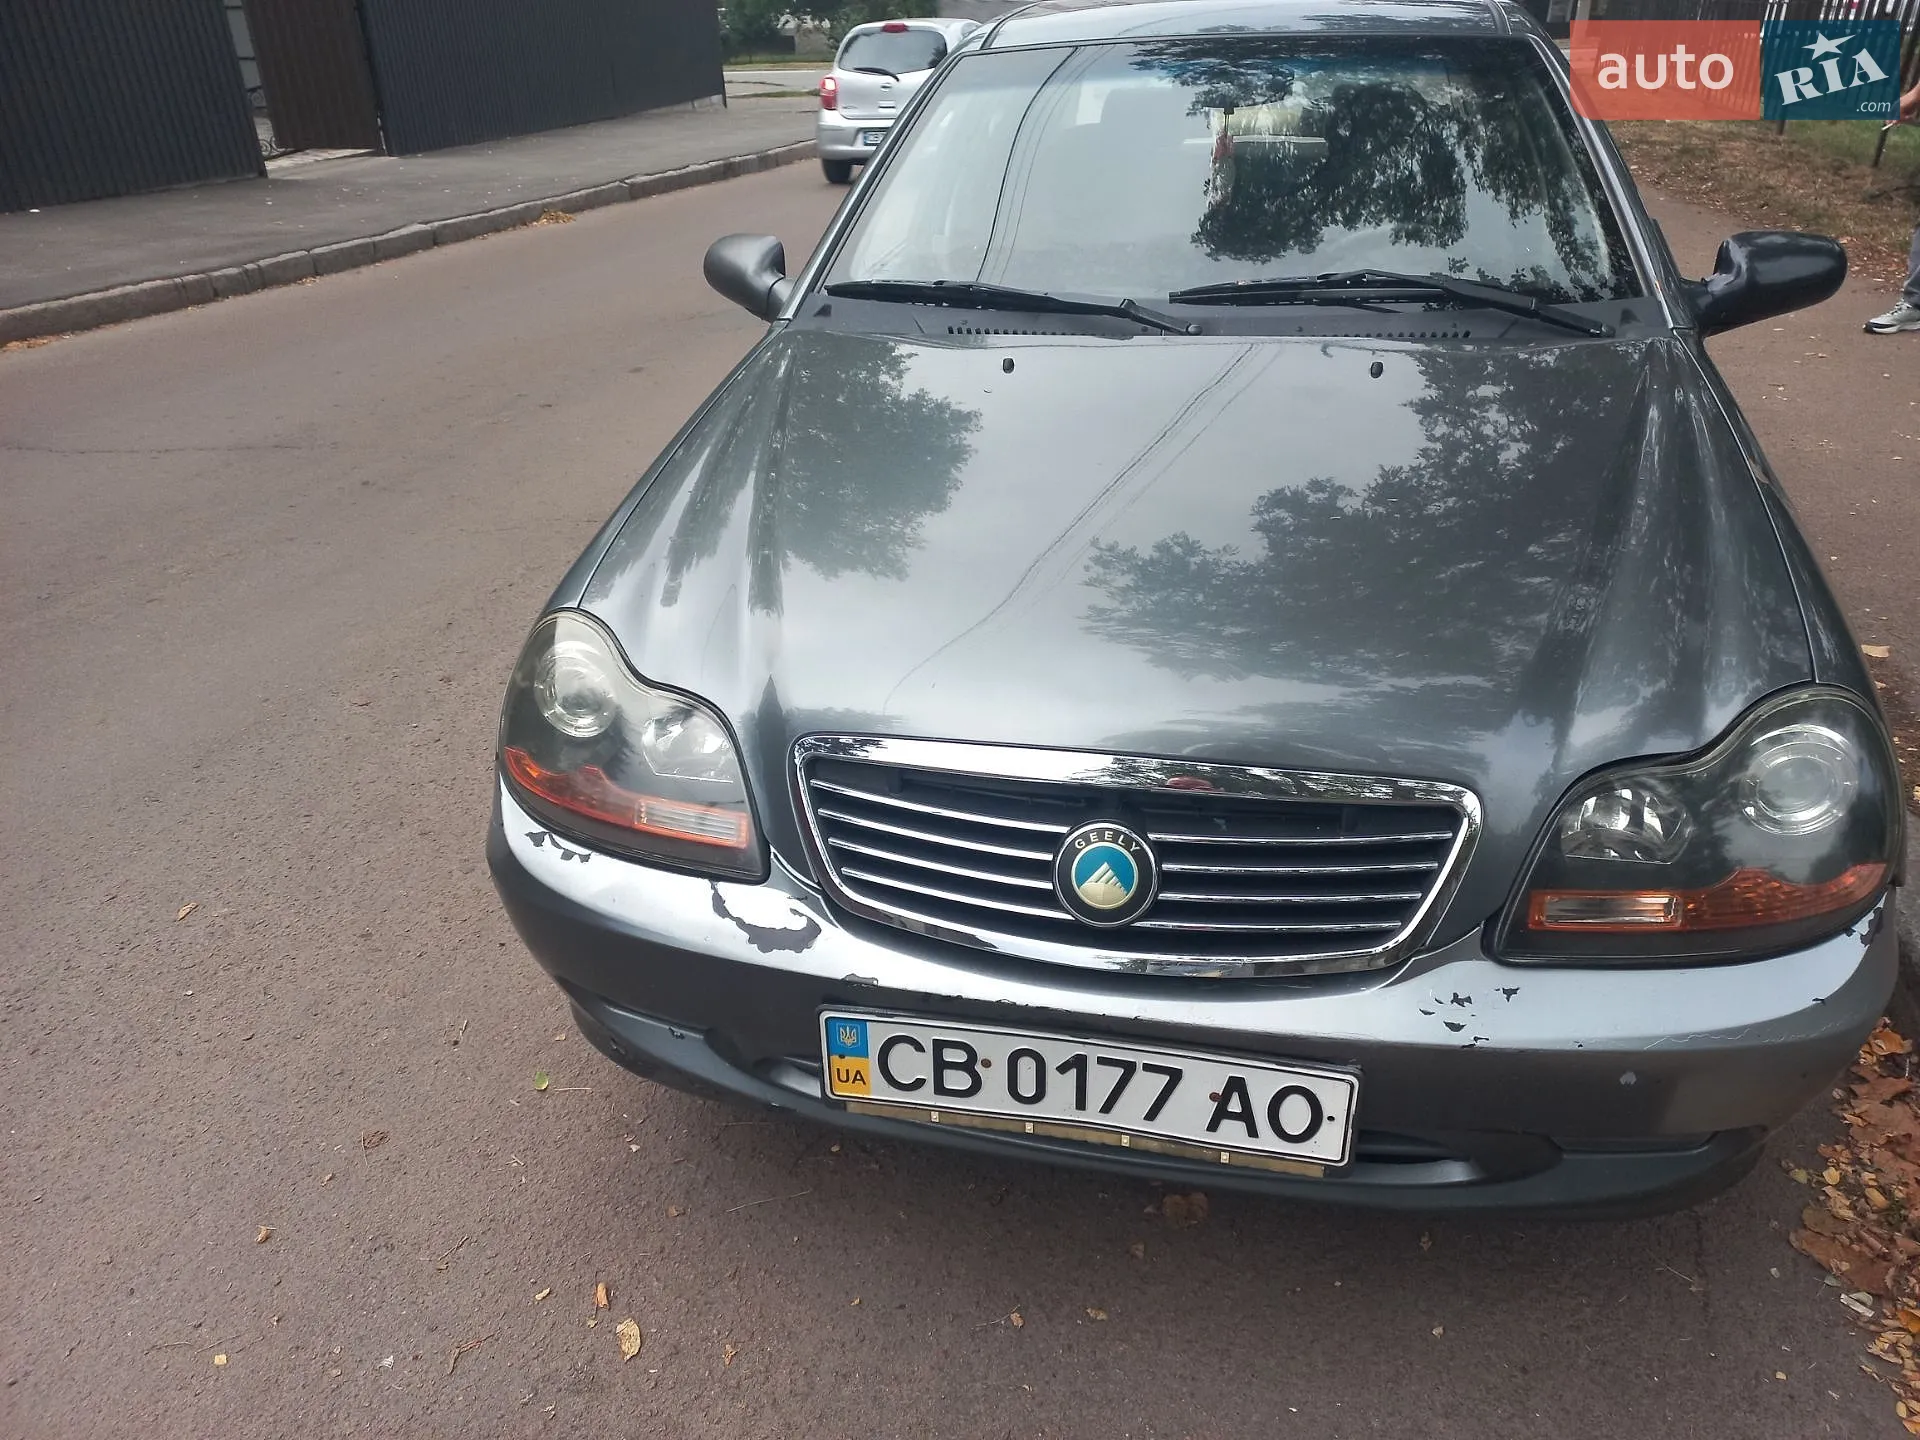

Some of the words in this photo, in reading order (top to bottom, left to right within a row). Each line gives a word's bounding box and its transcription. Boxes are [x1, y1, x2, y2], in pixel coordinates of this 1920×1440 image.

[1074, 830, 1141, 852] GEELY
[836, 1066, 867, 1086] UA
[1006, 1047, 1183, 1121] 0177
